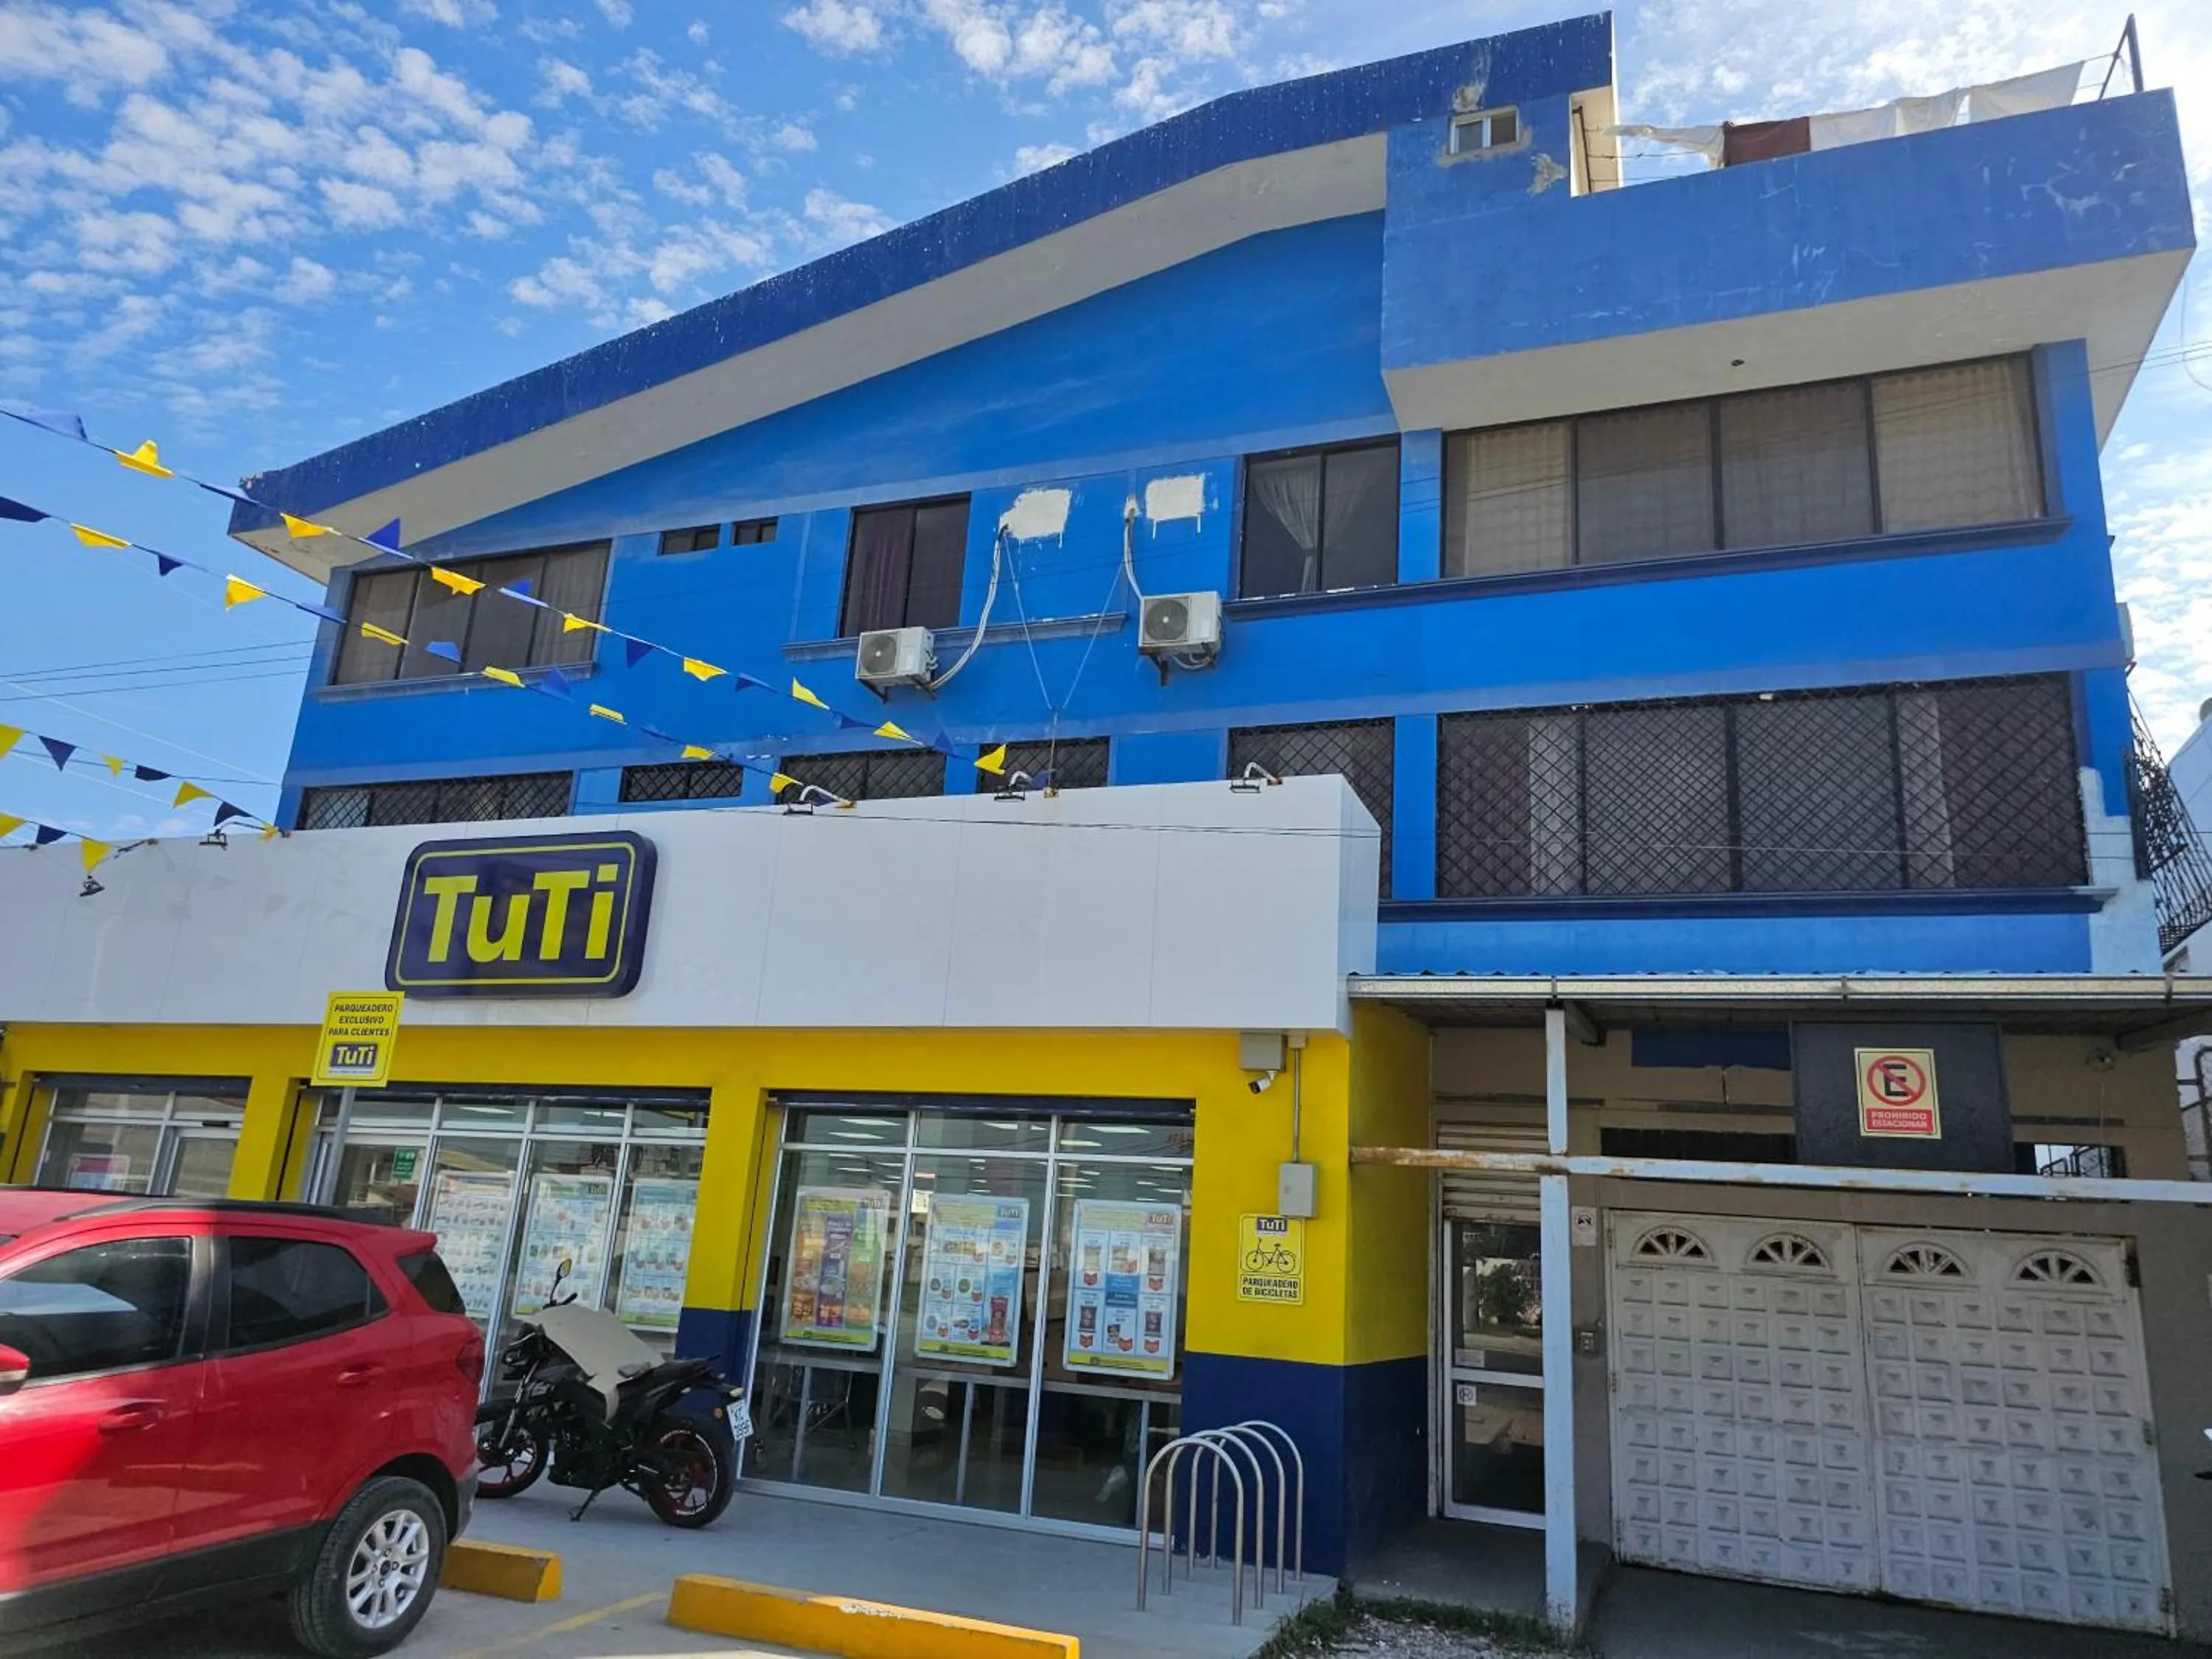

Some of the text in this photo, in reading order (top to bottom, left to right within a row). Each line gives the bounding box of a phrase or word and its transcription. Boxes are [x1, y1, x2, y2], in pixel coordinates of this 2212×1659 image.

[424, 863, 619, 962] TuTi
[334, 1004, 393, 1012] PARQUEADERO
[338, 1015, 384, 1024] EXCLUSIVO
[327, 1027, 390, 1036] PARA CLIENTES
[336, 1046, 375, 1065] TuTi
[1871, 1111, 1927, 1120] PROHIBIDO
[1872, 1119, 1927, 1128] ESTACIONAR
[1259, 1218, 1286, 1231] TuTi
[1242, 1277, 1298, 1289] PARQUEADERO
[1242, 1287, 1298, 1298] DE BICICLETAS
